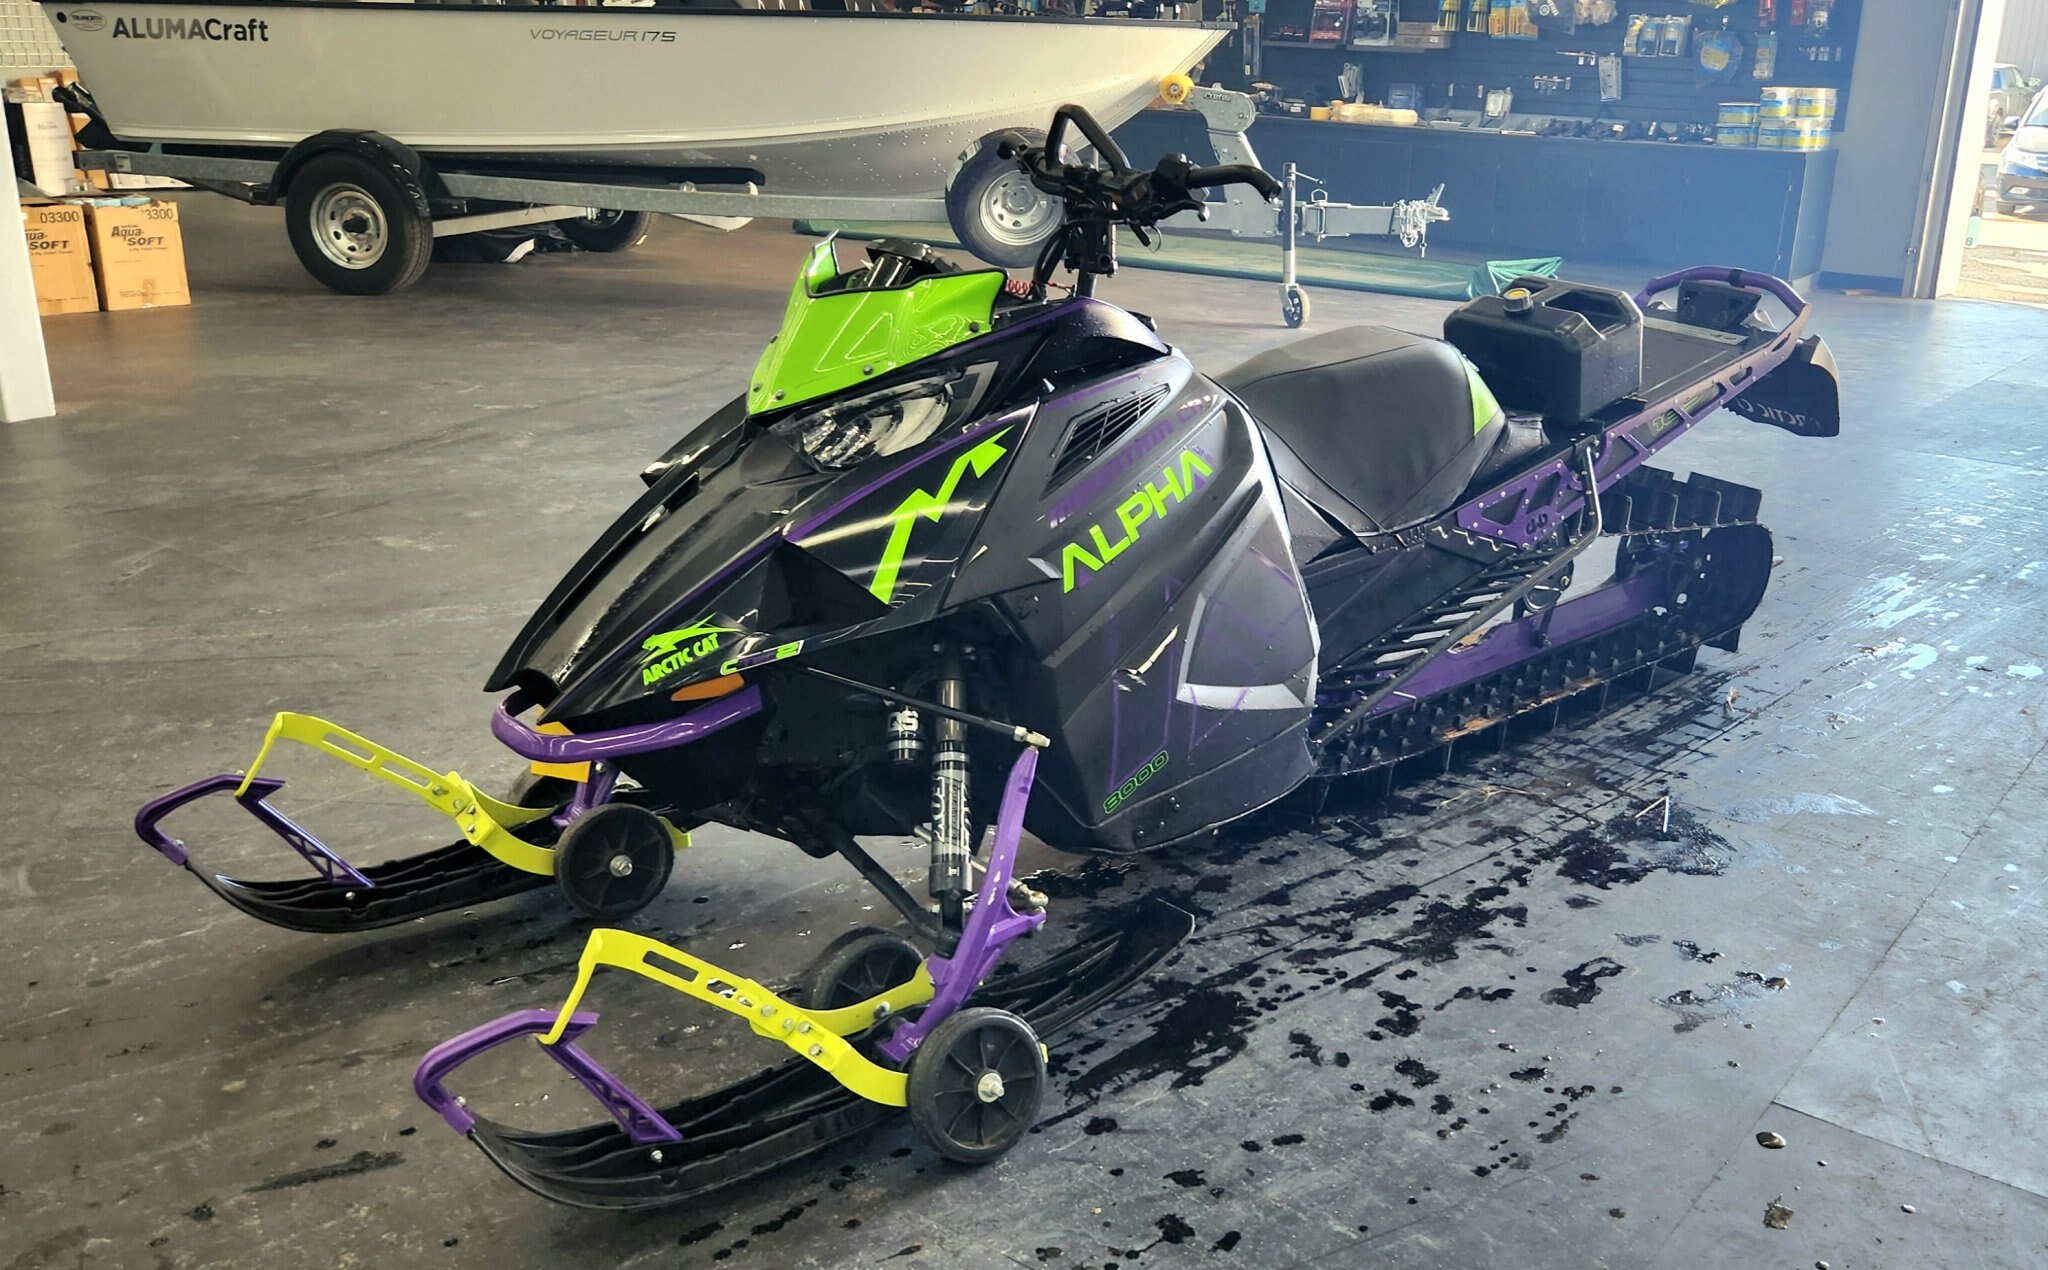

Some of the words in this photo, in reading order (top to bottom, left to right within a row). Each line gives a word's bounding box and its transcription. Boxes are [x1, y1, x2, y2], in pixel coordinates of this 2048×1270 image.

[112, 17, 269, 42] ALUMACraft
[530, 29, 638, 41] VOYAGEUR
[641, 31, 677, 42] 175
[40, 211, 80, 224] 03300
[141, 208, 173, 220] 3300
[29, 240, 69, 250] SOFT
[127, 236, 164, 246] SOFT
[1063, 450, 1213, 593] ALPHA
[642, 646, 694, 686] ARCTIC
[693, 633, 720, 657] CAT
[1103, 750, 1169, 814] 8000
